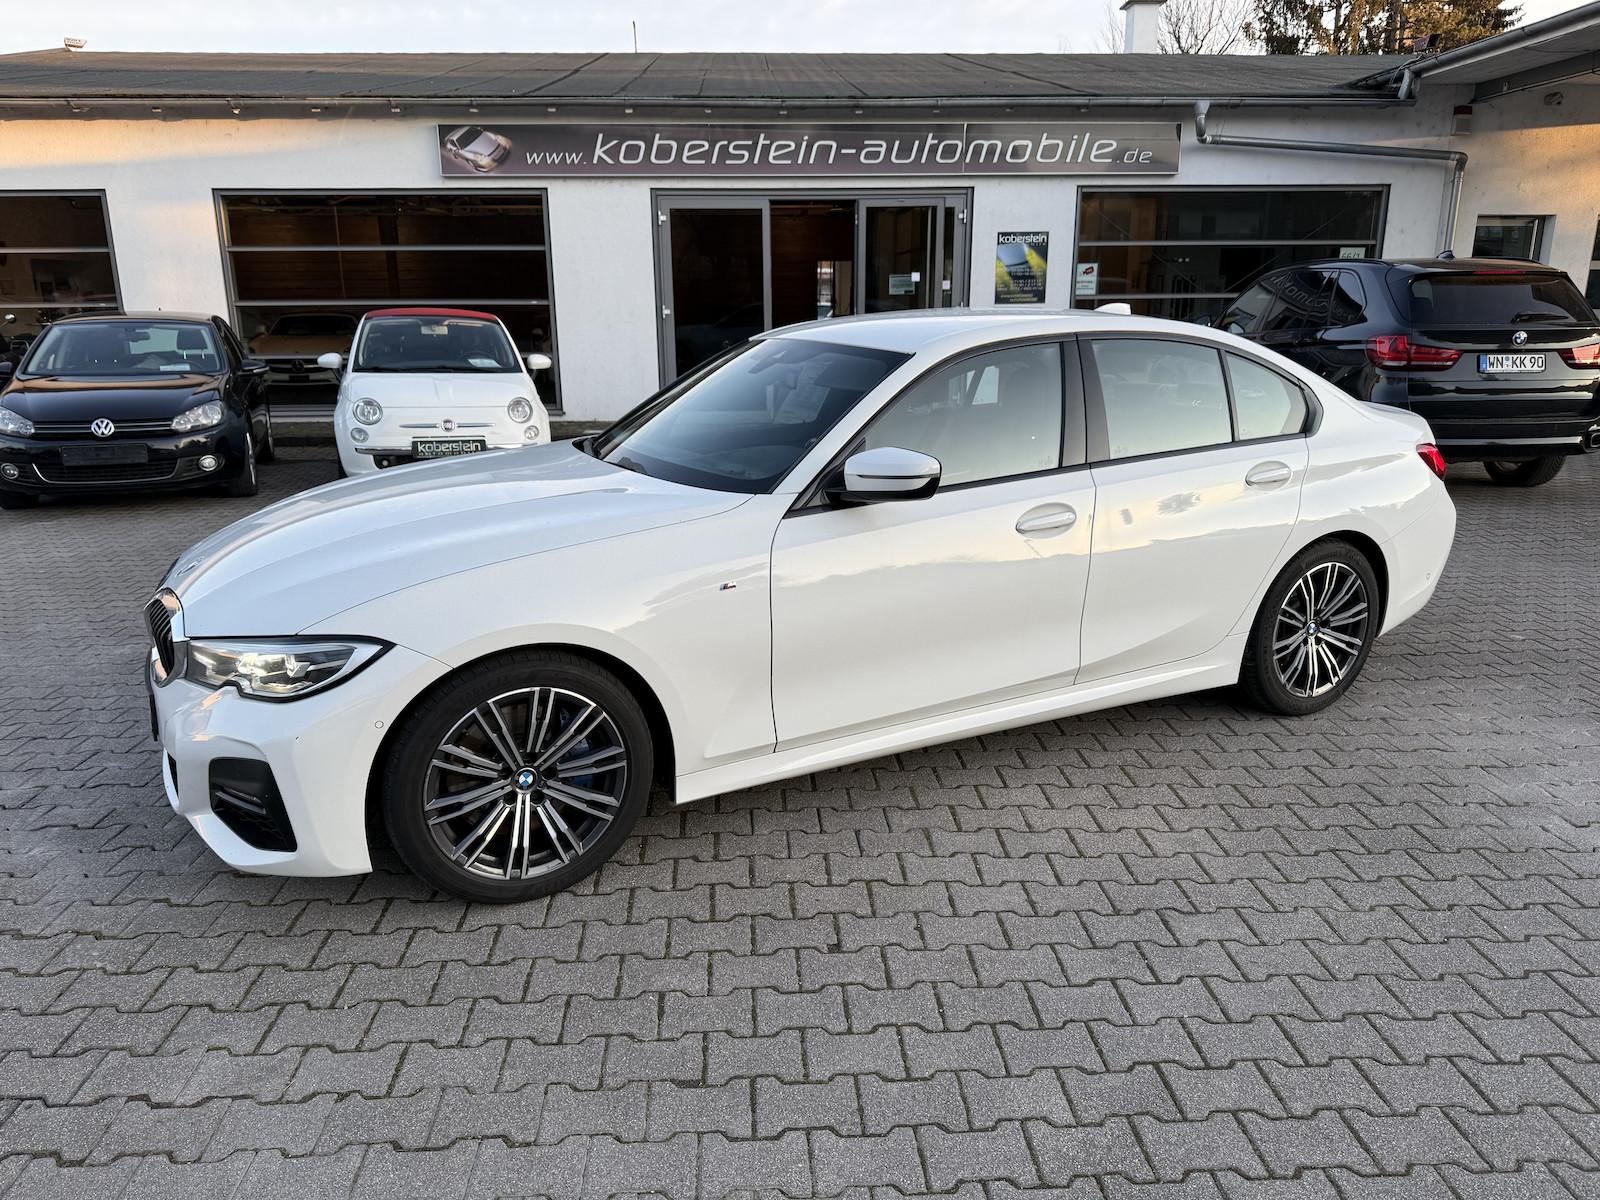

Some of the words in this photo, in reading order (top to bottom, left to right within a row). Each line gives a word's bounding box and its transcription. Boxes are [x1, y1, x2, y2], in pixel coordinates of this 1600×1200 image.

[525, 132, 1153, 165] www.koberstein-automobile.de
[999, 234, 1047, 244] koberstein
[1488, 356, 1504, 369] WN
[1511, 356, 1527, 369] KK
[1530, 356, 1544, 369] 90
[417, 440, 481, 452] koberstein
